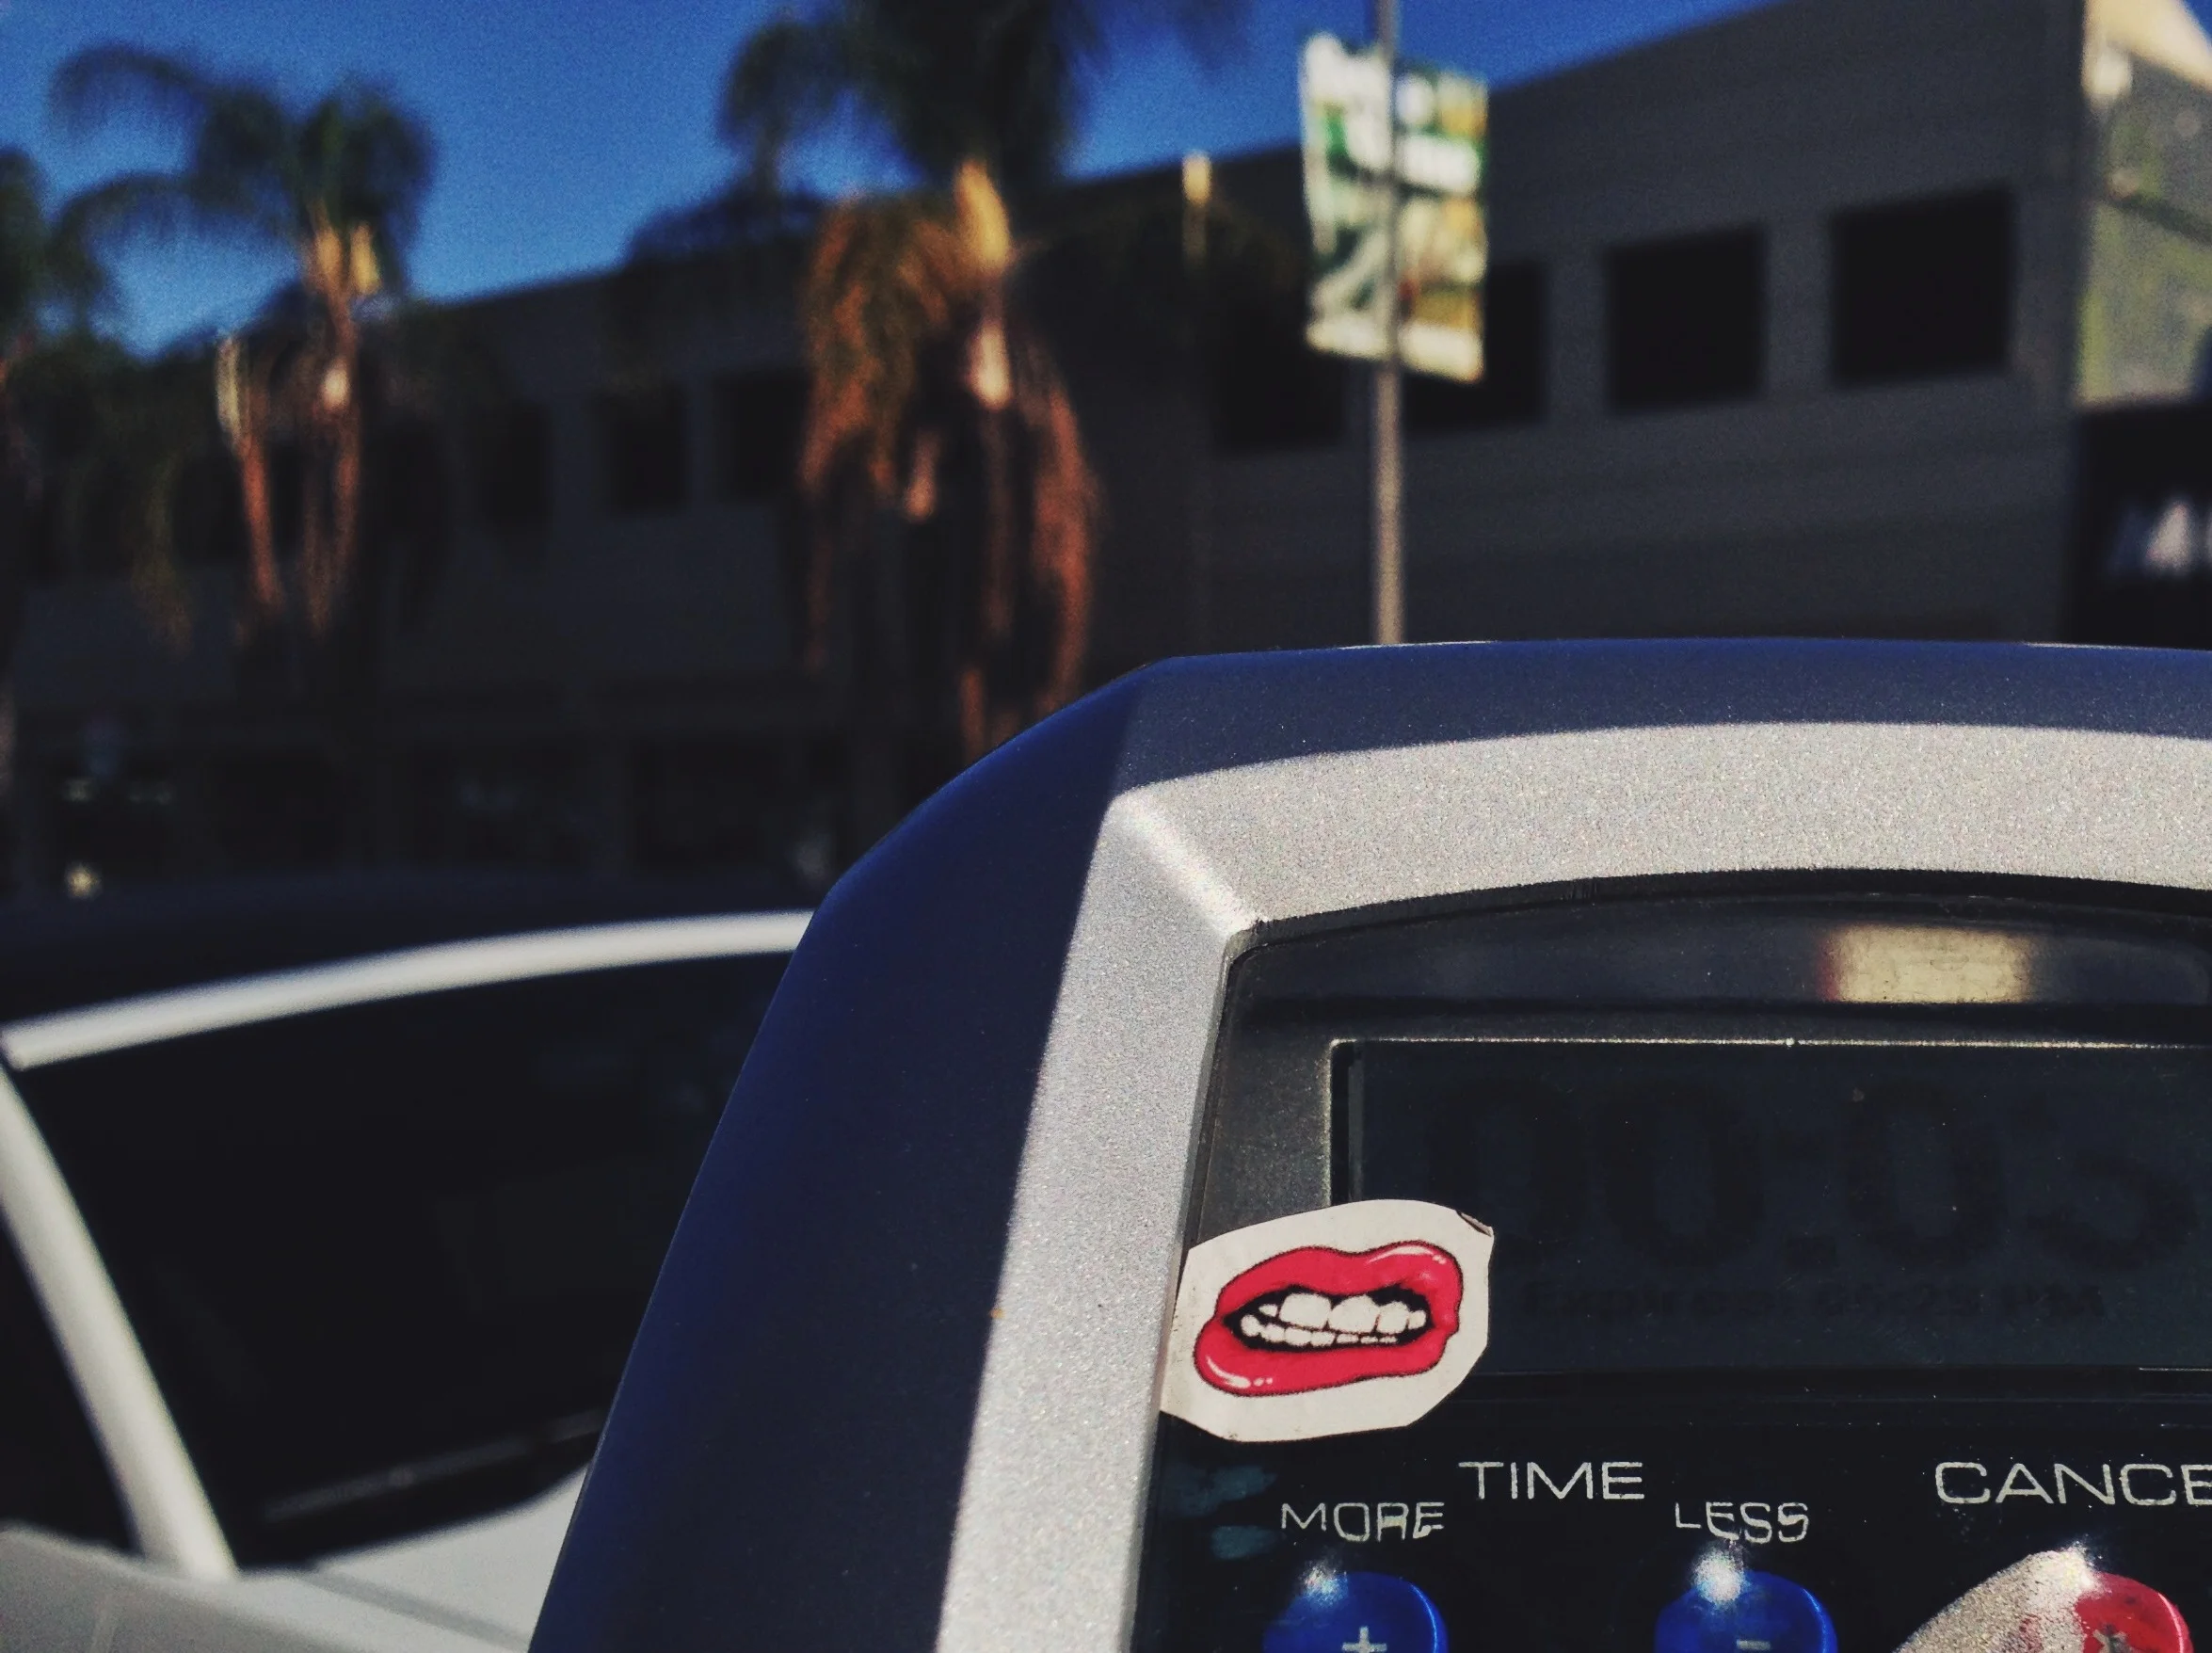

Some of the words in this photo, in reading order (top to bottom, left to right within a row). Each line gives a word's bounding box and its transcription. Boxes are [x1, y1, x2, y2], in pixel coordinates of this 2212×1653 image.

[1458, 1461, 1645, 1501] TIME
[1280, 1502, 1445, 1543] MORE
[1675, 1501, 1809, 1545] LESS
